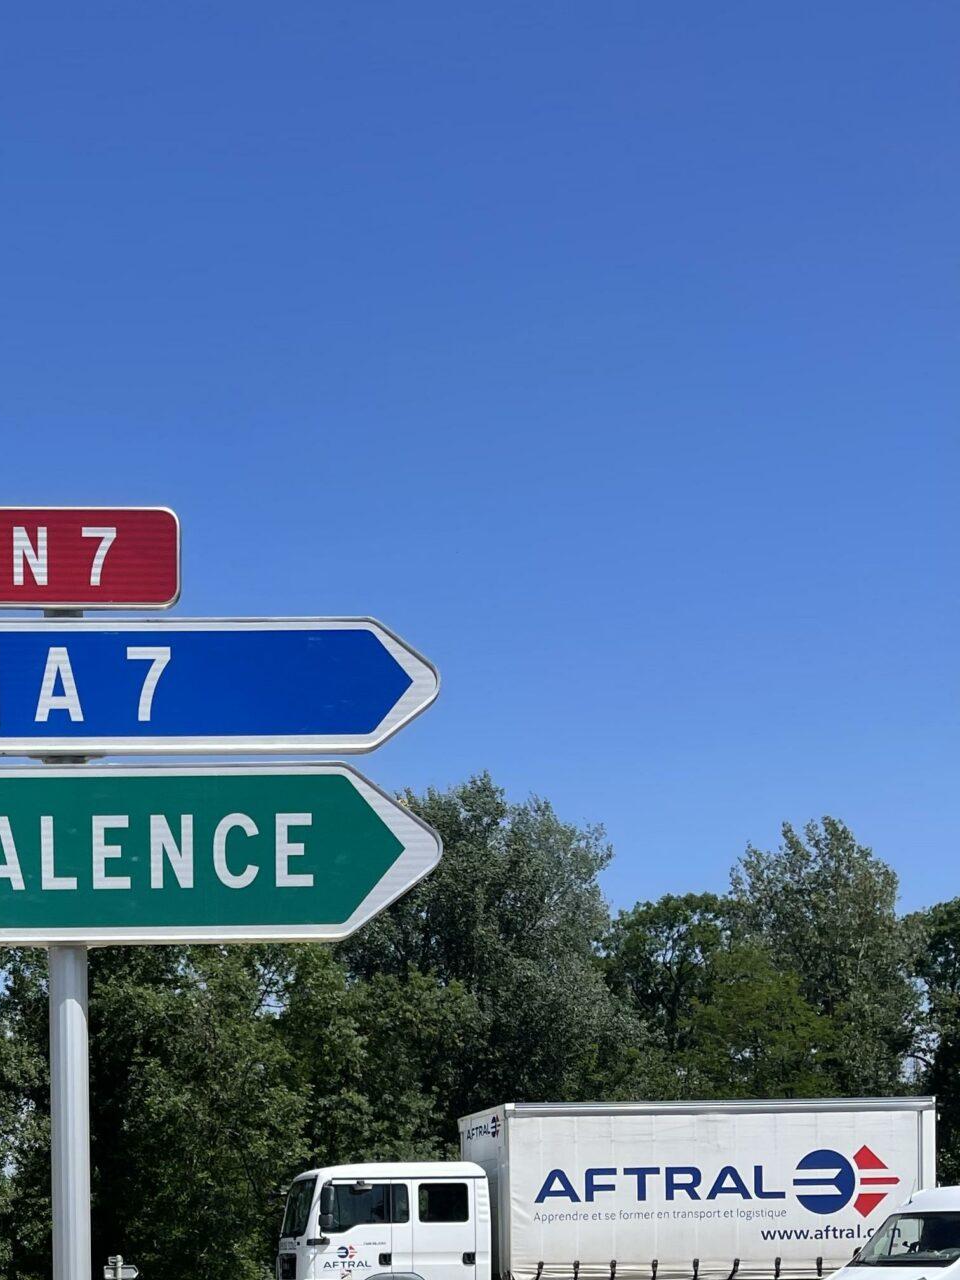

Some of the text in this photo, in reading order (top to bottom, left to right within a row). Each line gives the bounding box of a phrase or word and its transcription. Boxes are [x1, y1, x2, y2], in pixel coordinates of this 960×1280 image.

[12, 526, 117, 586] N 7
[34, 646, 172, 722] A 7
[466, 1123, 490, 1140] AFTRAL
[534, 1165, 786, 1204] AFTRAL
[533, 1208, 788, 1224] Apprendre et se former en transport et logistique
[761, 1224, 901, 1240] www.aftral.cm
[323, 1260, 372, 1269] AFTRAL
